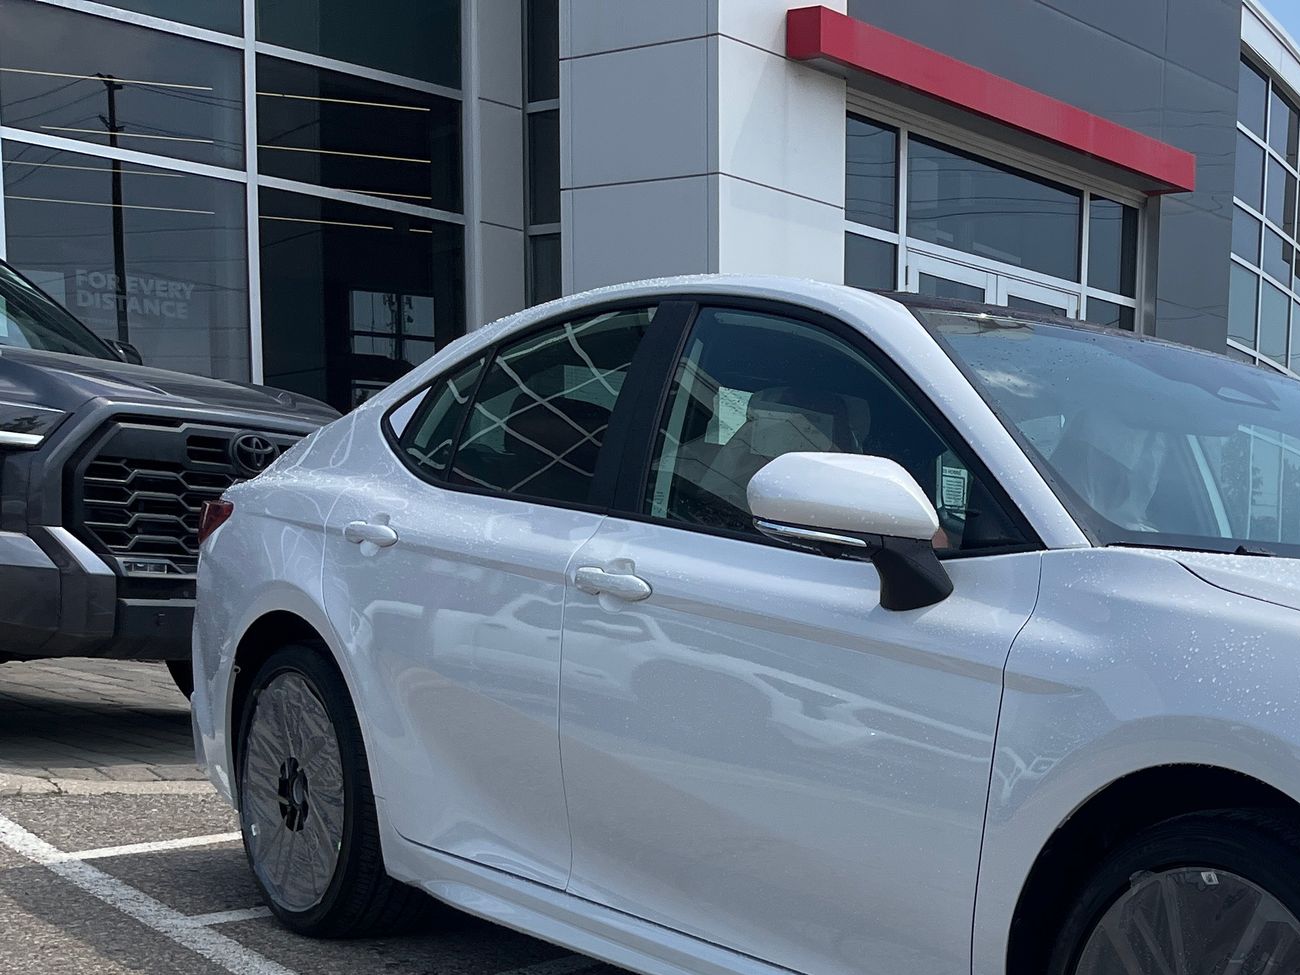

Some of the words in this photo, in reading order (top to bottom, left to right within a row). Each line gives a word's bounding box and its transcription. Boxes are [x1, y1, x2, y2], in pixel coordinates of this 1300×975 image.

[76, 269, 120, 291] FOR
[126, 275, 195, 299] EVERY
[76, 290, 189, 320] DISTANCE
